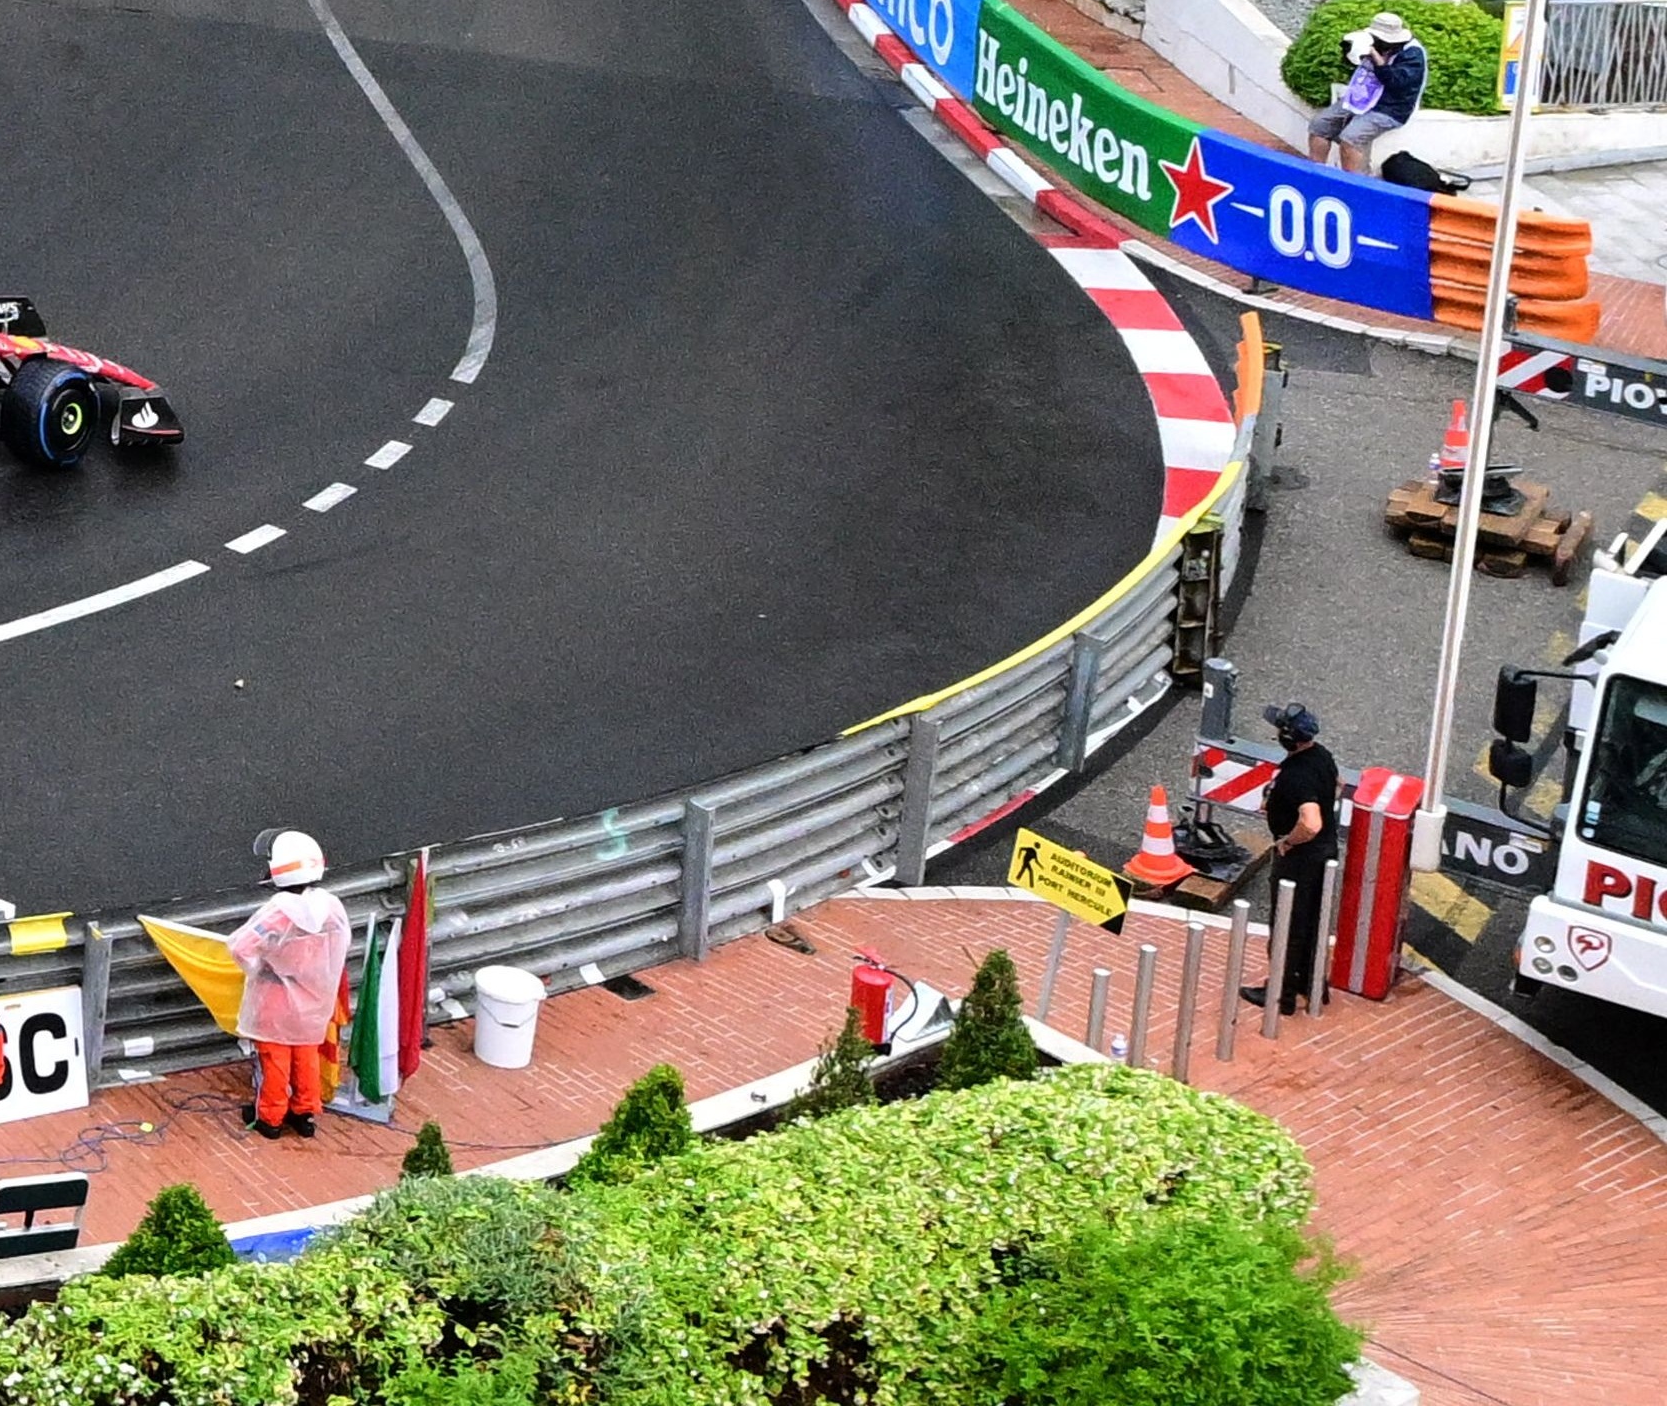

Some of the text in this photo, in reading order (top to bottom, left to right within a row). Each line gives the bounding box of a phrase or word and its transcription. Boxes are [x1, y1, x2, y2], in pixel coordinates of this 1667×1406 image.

[977, 37, 1152, 202] Heineken
[1050, 853, 1112, 888] AUDITORIUM
[1441, 831, 1529, 875] NO
[1038, 874, 1113, 917] PORT HERCULE
[1051, 865, 1091, 889] RAINIER
[1583, 860, 1667, 922] PI
